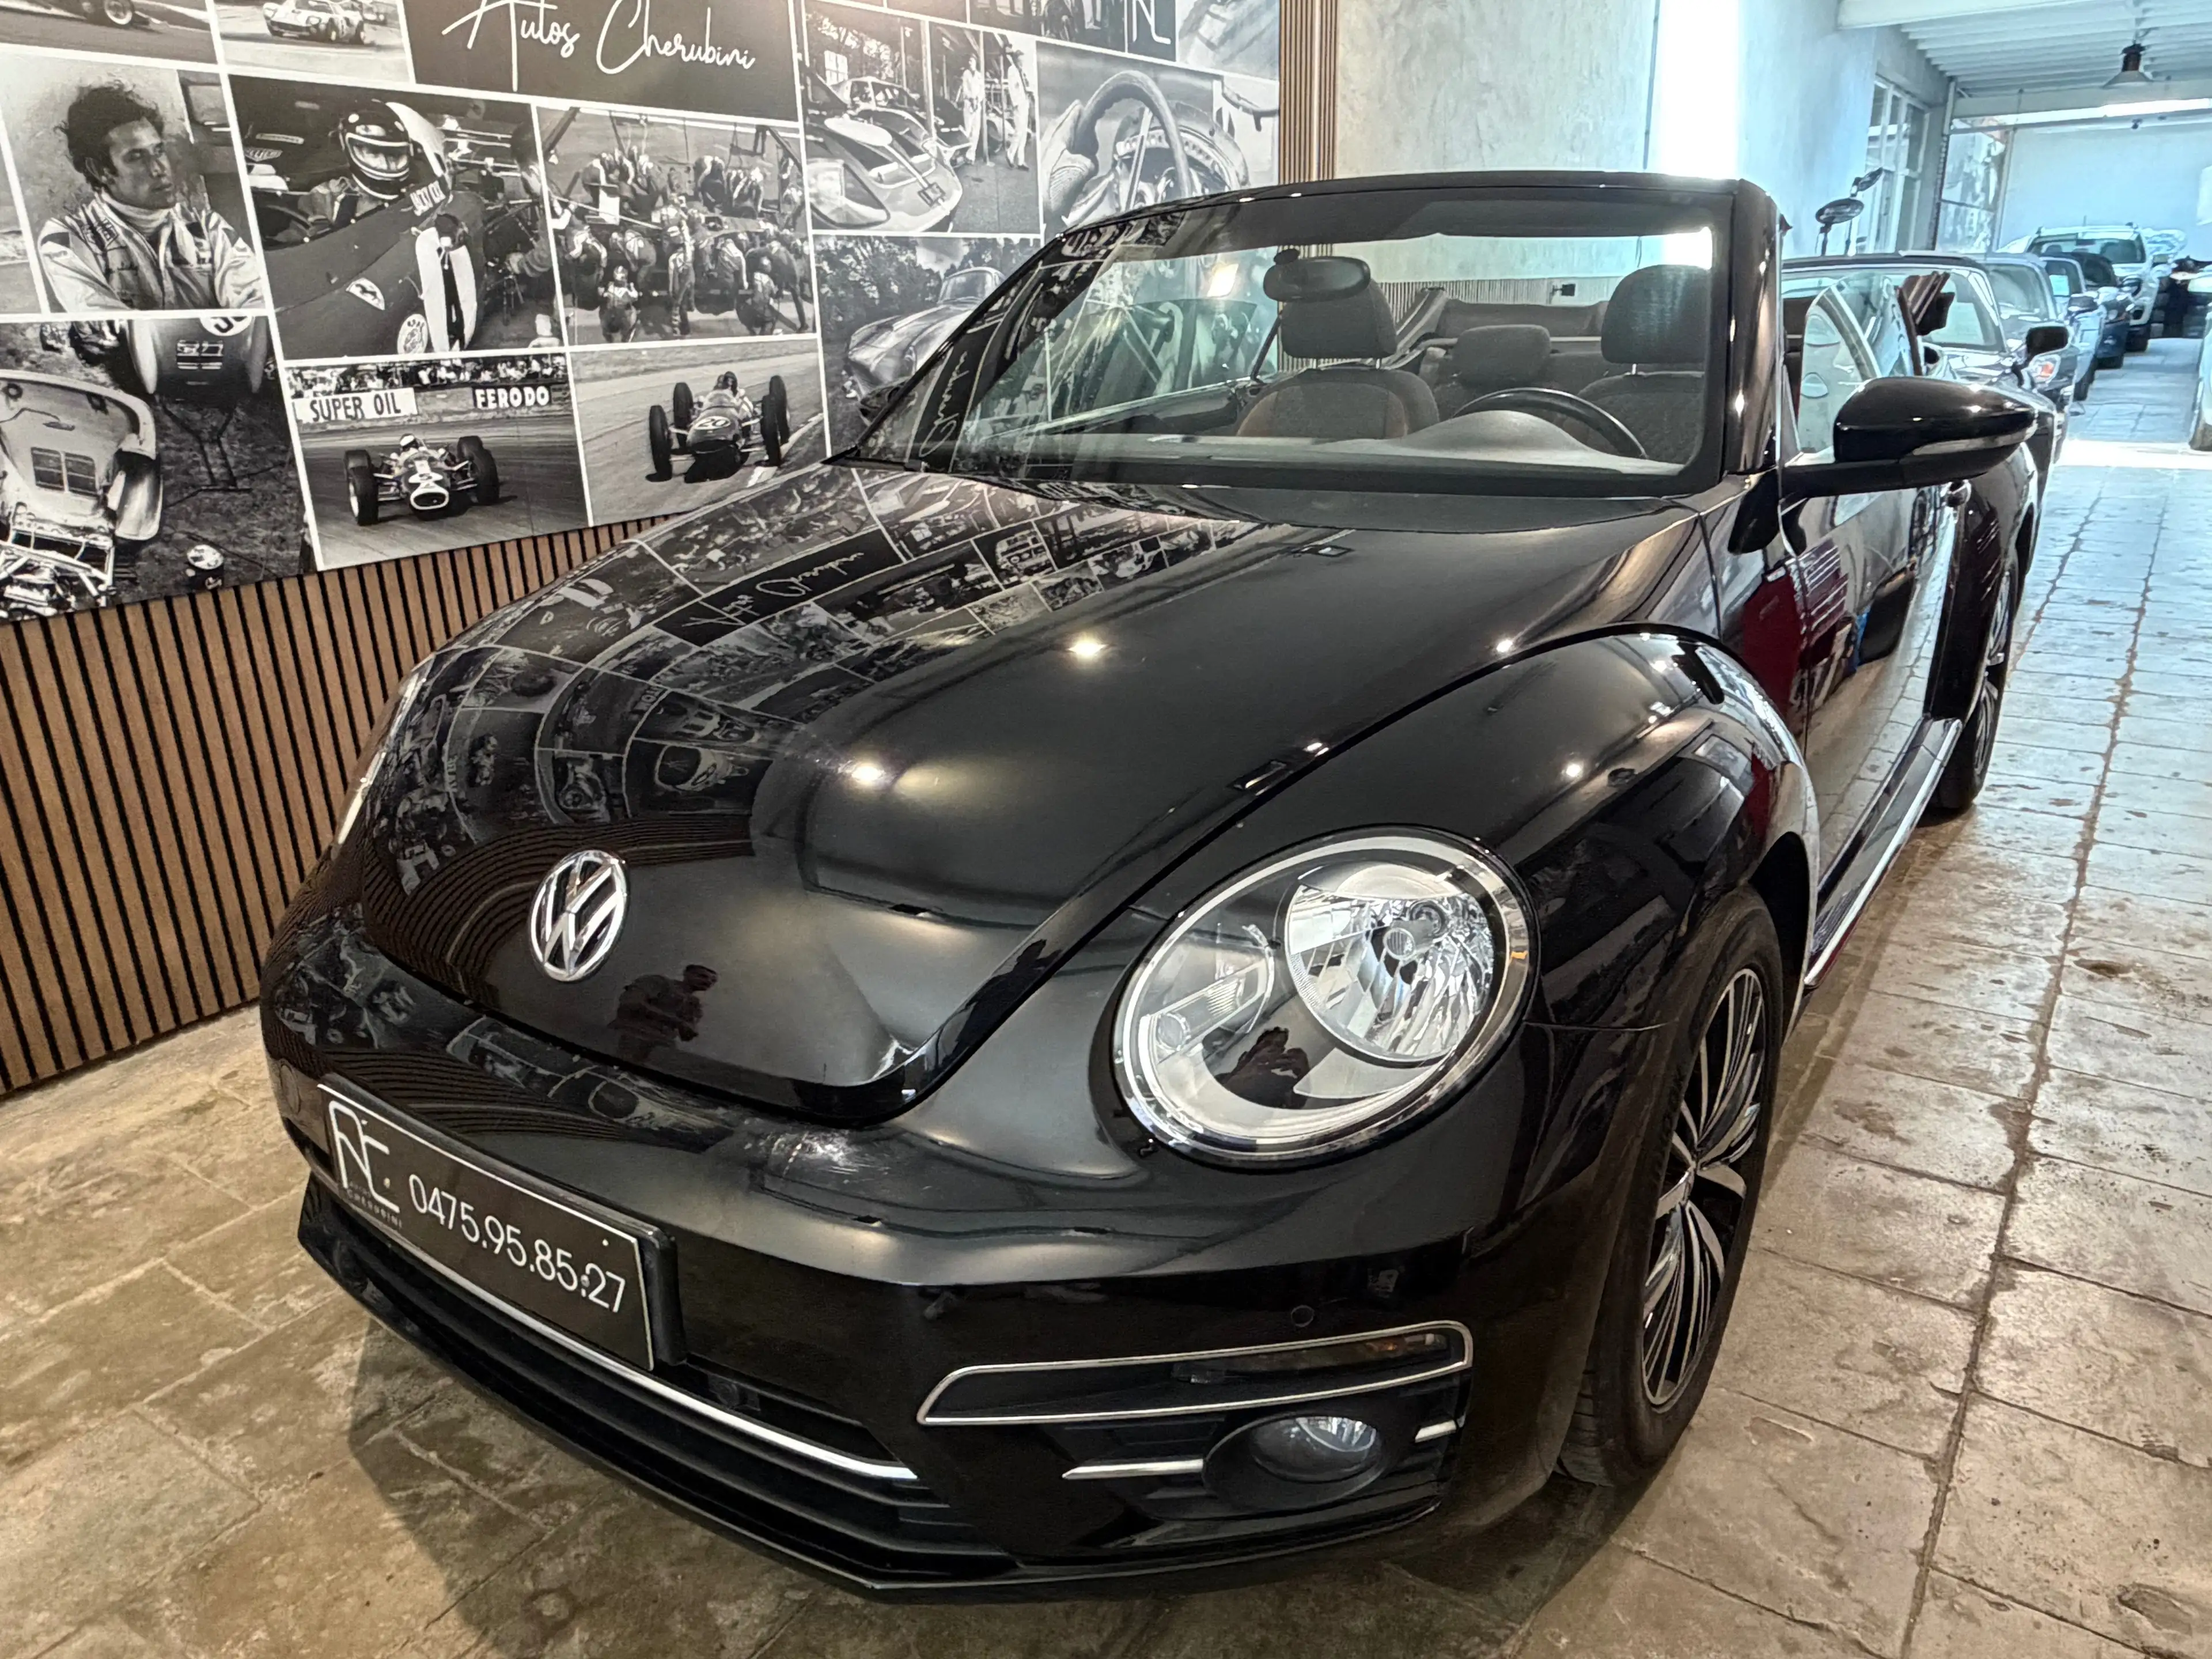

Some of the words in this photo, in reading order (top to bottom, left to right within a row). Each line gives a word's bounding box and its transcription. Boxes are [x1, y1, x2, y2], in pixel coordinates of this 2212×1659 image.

[441, 0, 581, 92] Autos
[596, 0, 756, 74] Cherubini
[309, 396, 365, 422] SUPER
[374, 392, 402, 415] OIL
[475, 385, 550, 410] FERODO
[697, 418, 729, 427] 20
[408, 1173, 626, 1313] 0475.95.85.27
